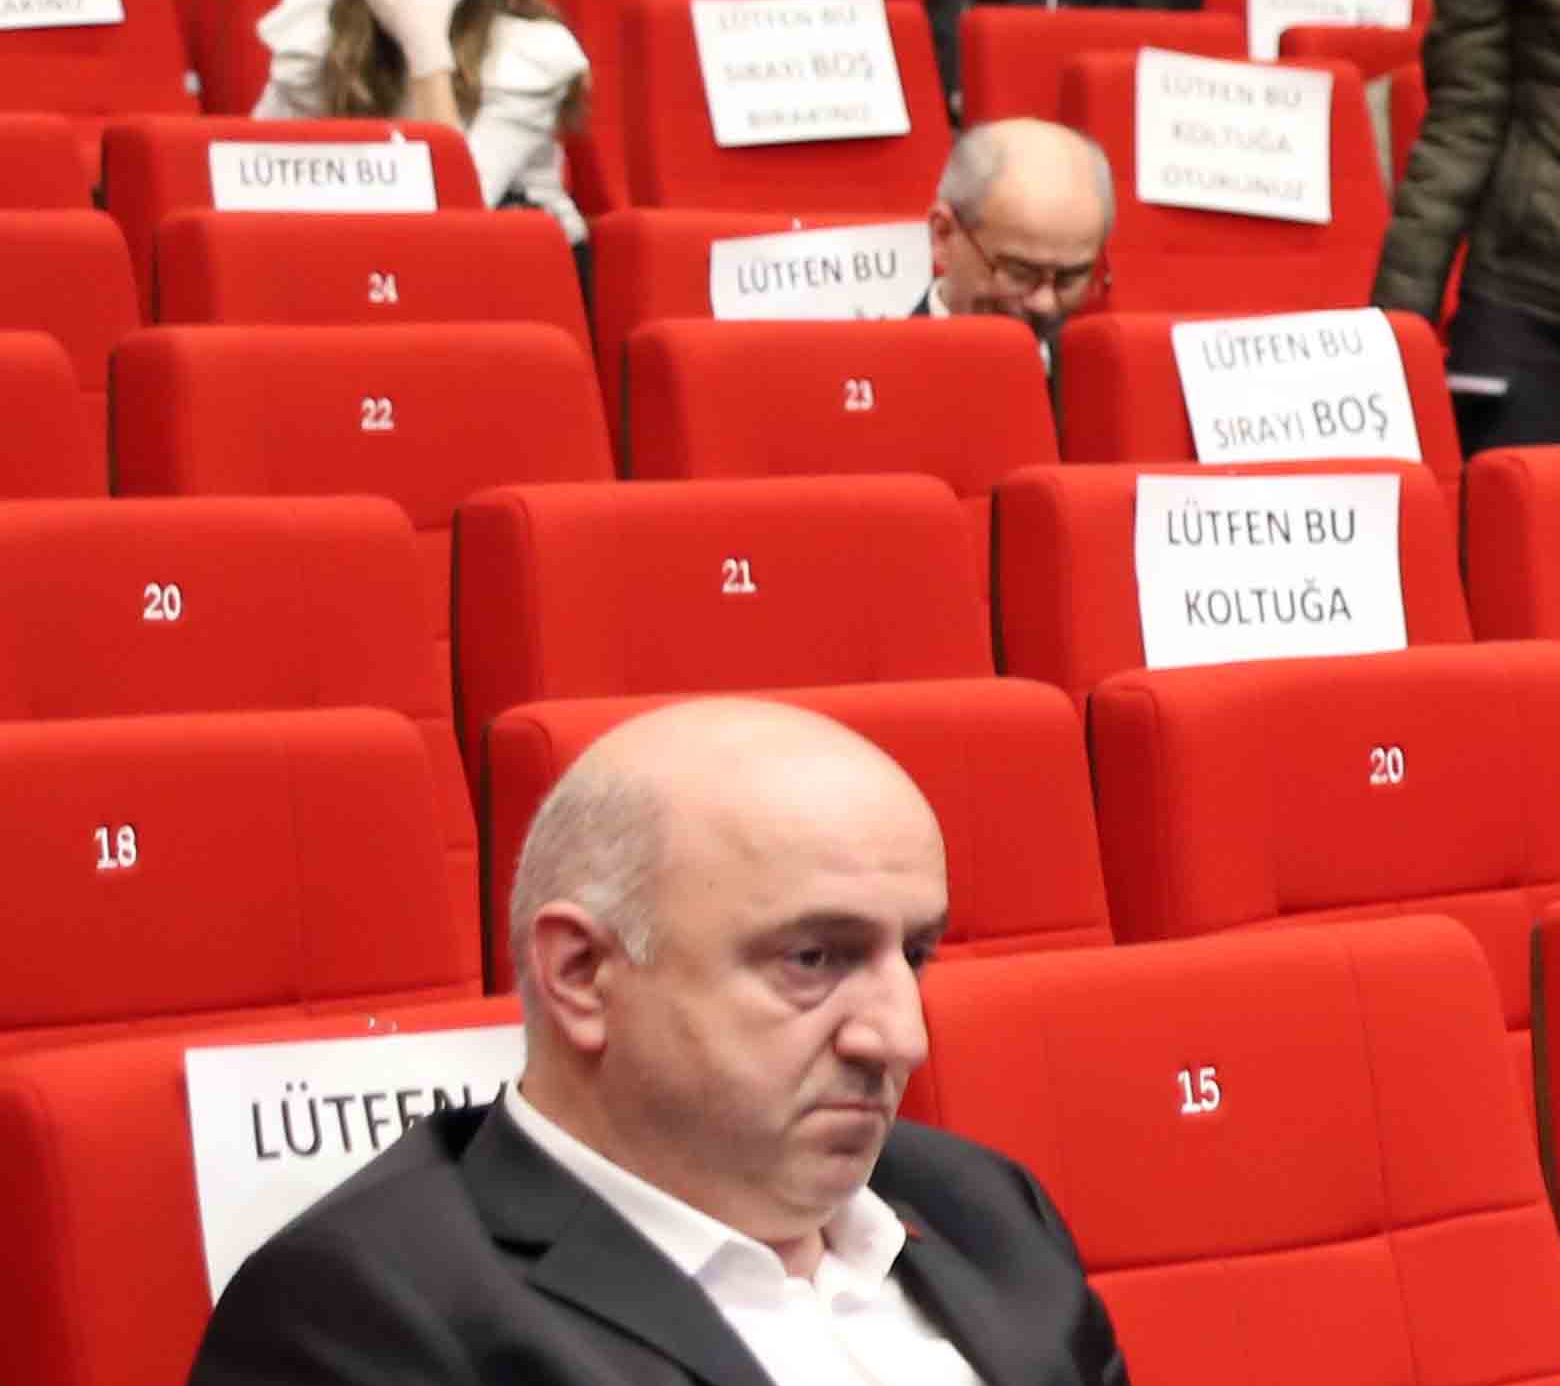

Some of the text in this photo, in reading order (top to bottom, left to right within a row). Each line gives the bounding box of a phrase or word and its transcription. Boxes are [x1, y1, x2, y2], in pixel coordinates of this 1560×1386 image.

[239, 155, 398, 188] LÜTFEN BU
[368, 272, 399, 303] 24
[737, 249, 897, 296] LÜTFEN BU
[1202, 327, 1364, 371] LÜTFEN BU
[360, 398, 394, 430] 22
[1212, 391, 1388, 450] SIRAYI BOŞ
[1167, 496, 1357, 547] LÜTFEN BU
[722, 558, 757, 594] 21
[143, 582, 182, 621] 20
[1185, 576, 1353, 627] KOLTUĞA
[1369, 746, 1406, 785] 20
[94, 825, 138, 871] 18
[1176, 1067, 1221, 1116] 15
